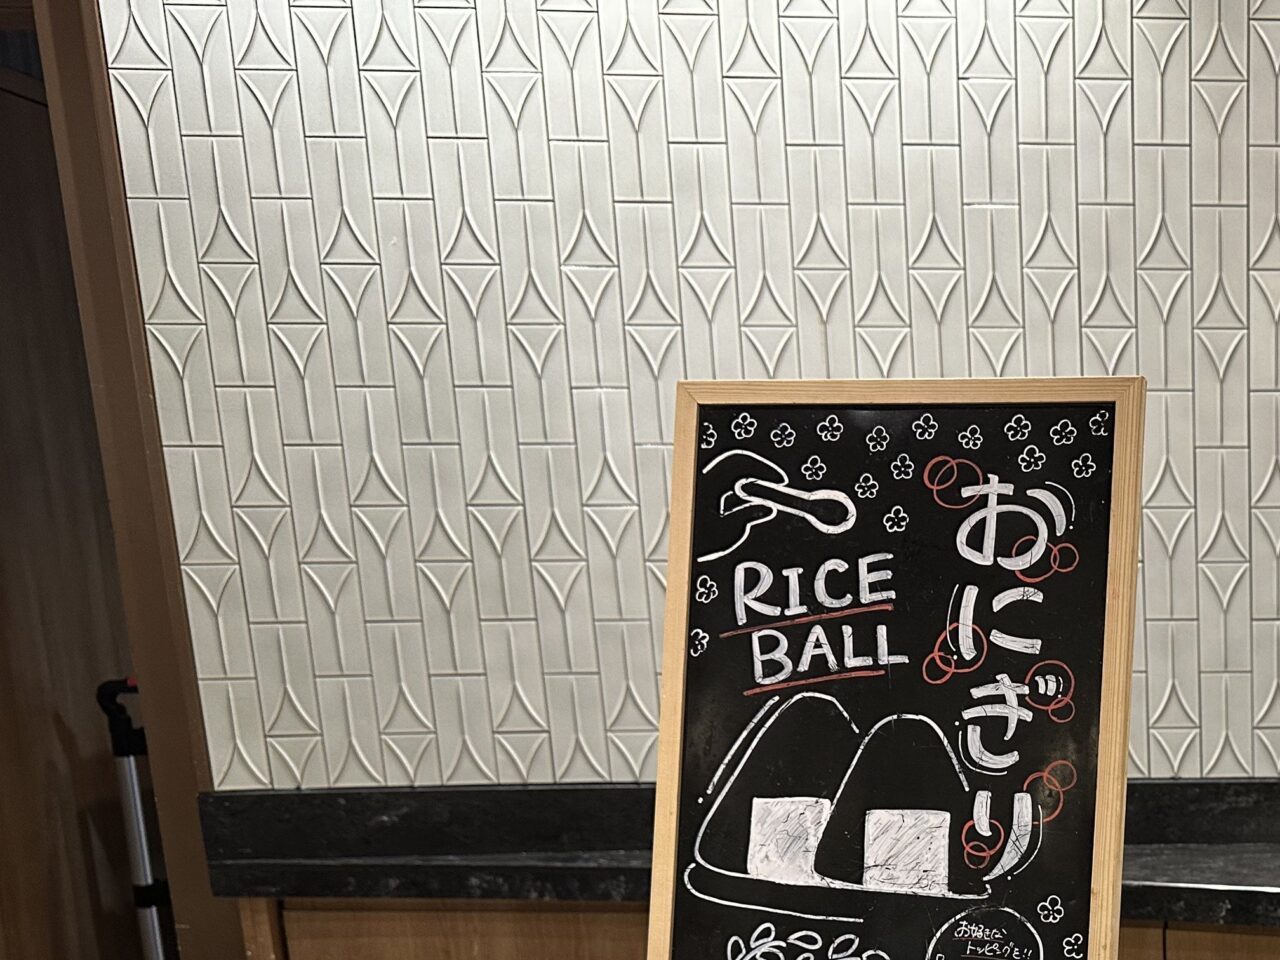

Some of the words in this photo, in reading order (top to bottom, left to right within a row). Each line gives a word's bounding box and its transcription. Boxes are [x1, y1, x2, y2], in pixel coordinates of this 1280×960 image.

[735, 553, 897, 625] RICE
[751, 625, 909, 685] BALL
[956, 473, 1066, 881] おにぎり
[954, 920, 1007, 940] お好きな
